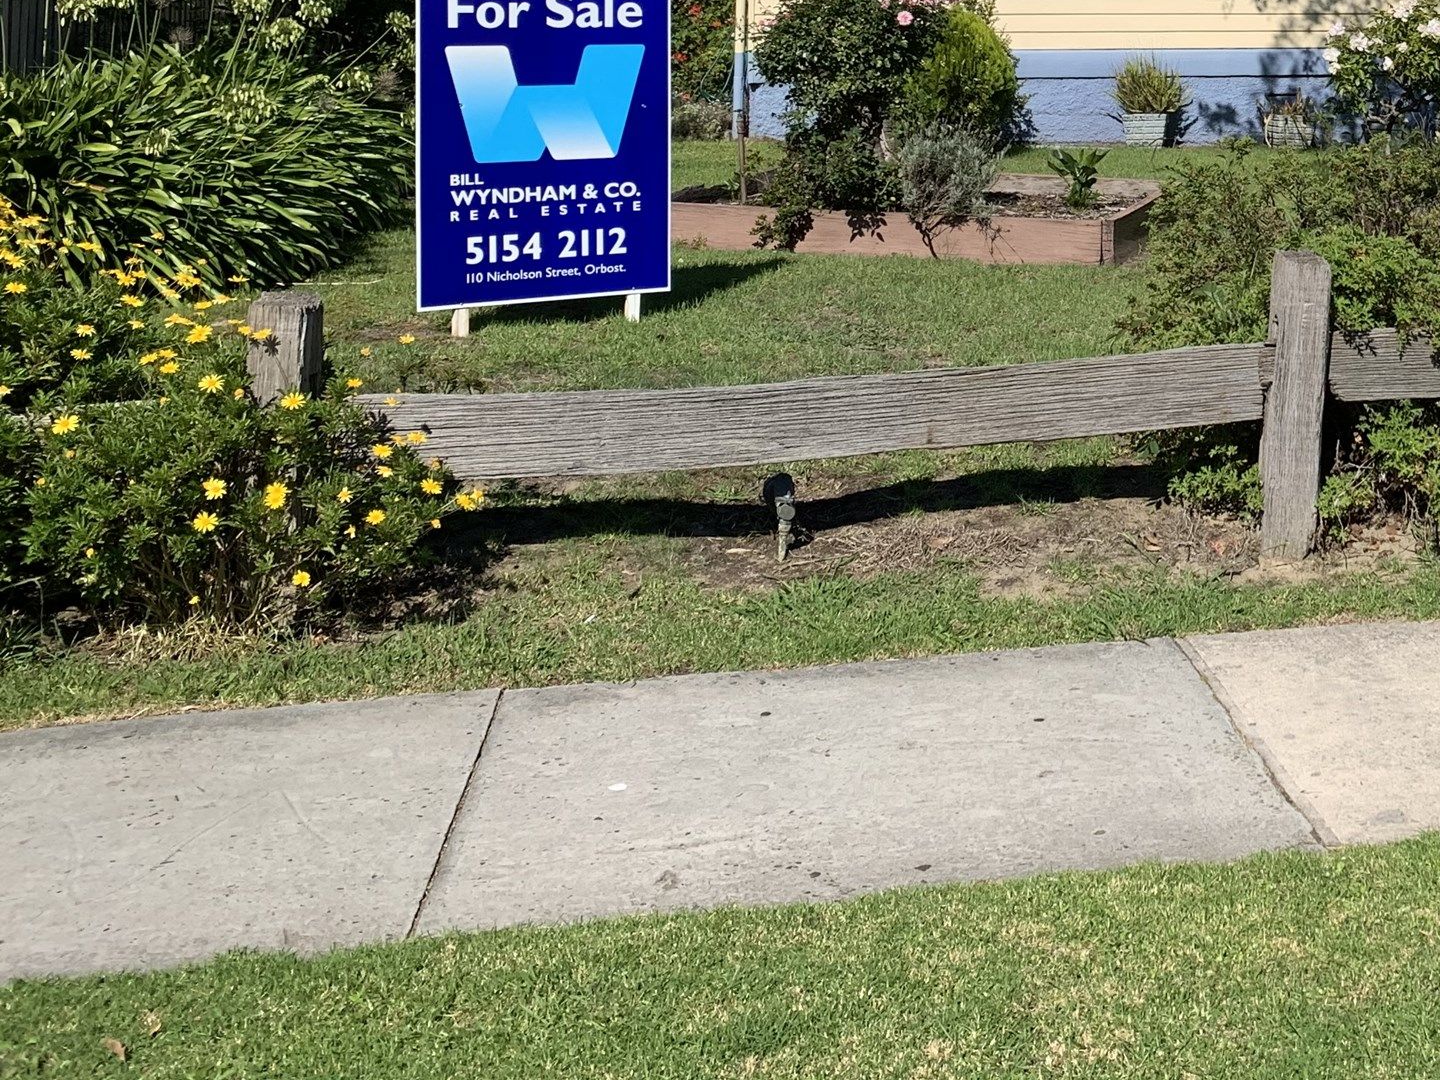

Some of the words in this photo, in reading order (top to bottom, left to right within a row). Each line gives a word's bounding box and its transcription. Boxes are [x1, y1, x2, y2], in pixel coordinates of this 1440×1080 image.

[450, 173, 484, 187] BILL
[450, 184, 577, 207] WYNDHAM
[582, 183, 598, 200] &
[604, 181, 641, 198] CO.
[450, 207, 519, 222] REAL
[541, 201, 641, 217] ESTATE
[465, 232, 542, 265] 5154
[558, 227, 628, 258] 2112
[466, 271, 483, 284] 110
[486, 267, 543, 283] Nicholson
[545, 266, 581, 280] Street,
[584, 263, 627, 276] Orbost.
